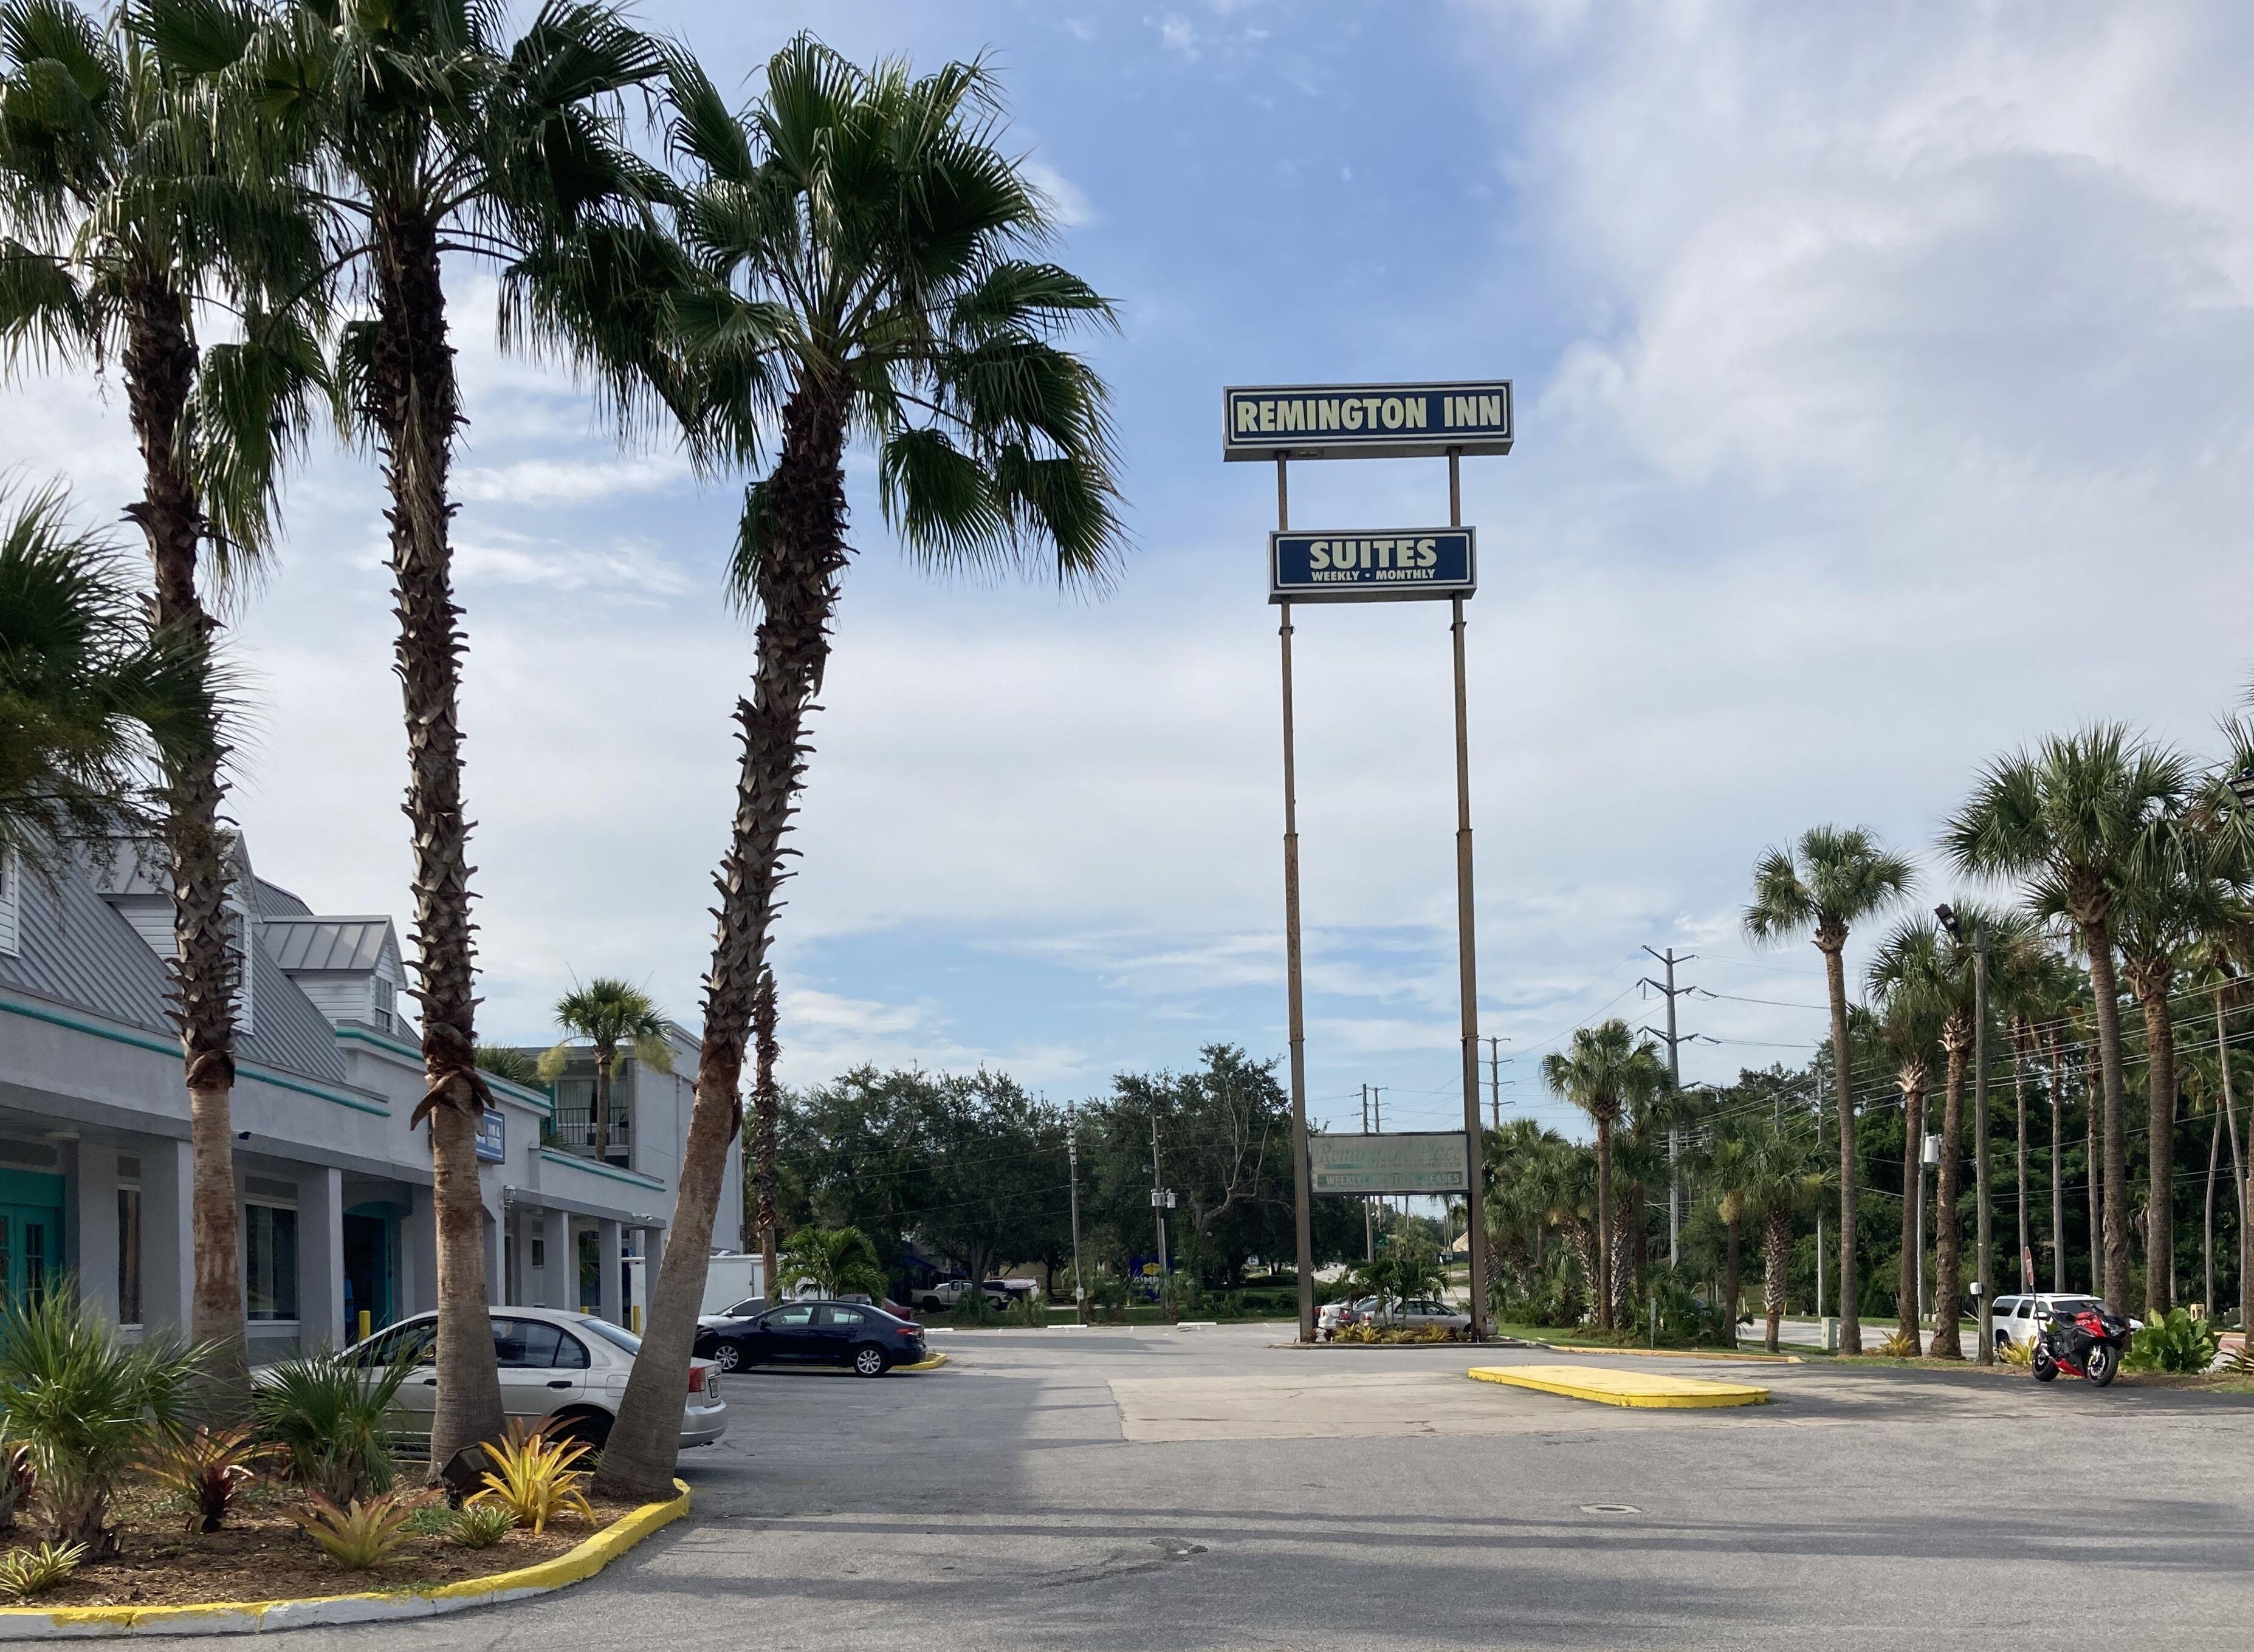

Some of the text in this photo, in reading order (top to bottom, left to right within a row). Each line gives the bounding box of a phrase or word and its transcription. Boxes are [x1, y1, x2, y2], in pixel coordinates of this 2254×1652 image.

[1237, 396, 1501, 432] REMINGTON INN
[1310, 539, 1437, 569] SUITES
[1311, 569, 1435, 581] WEEKLY MONTHLY
[1318, 1143, 1403, 1165] Remgon
[1326, 1176, 1361, 1185] WEEKLY
